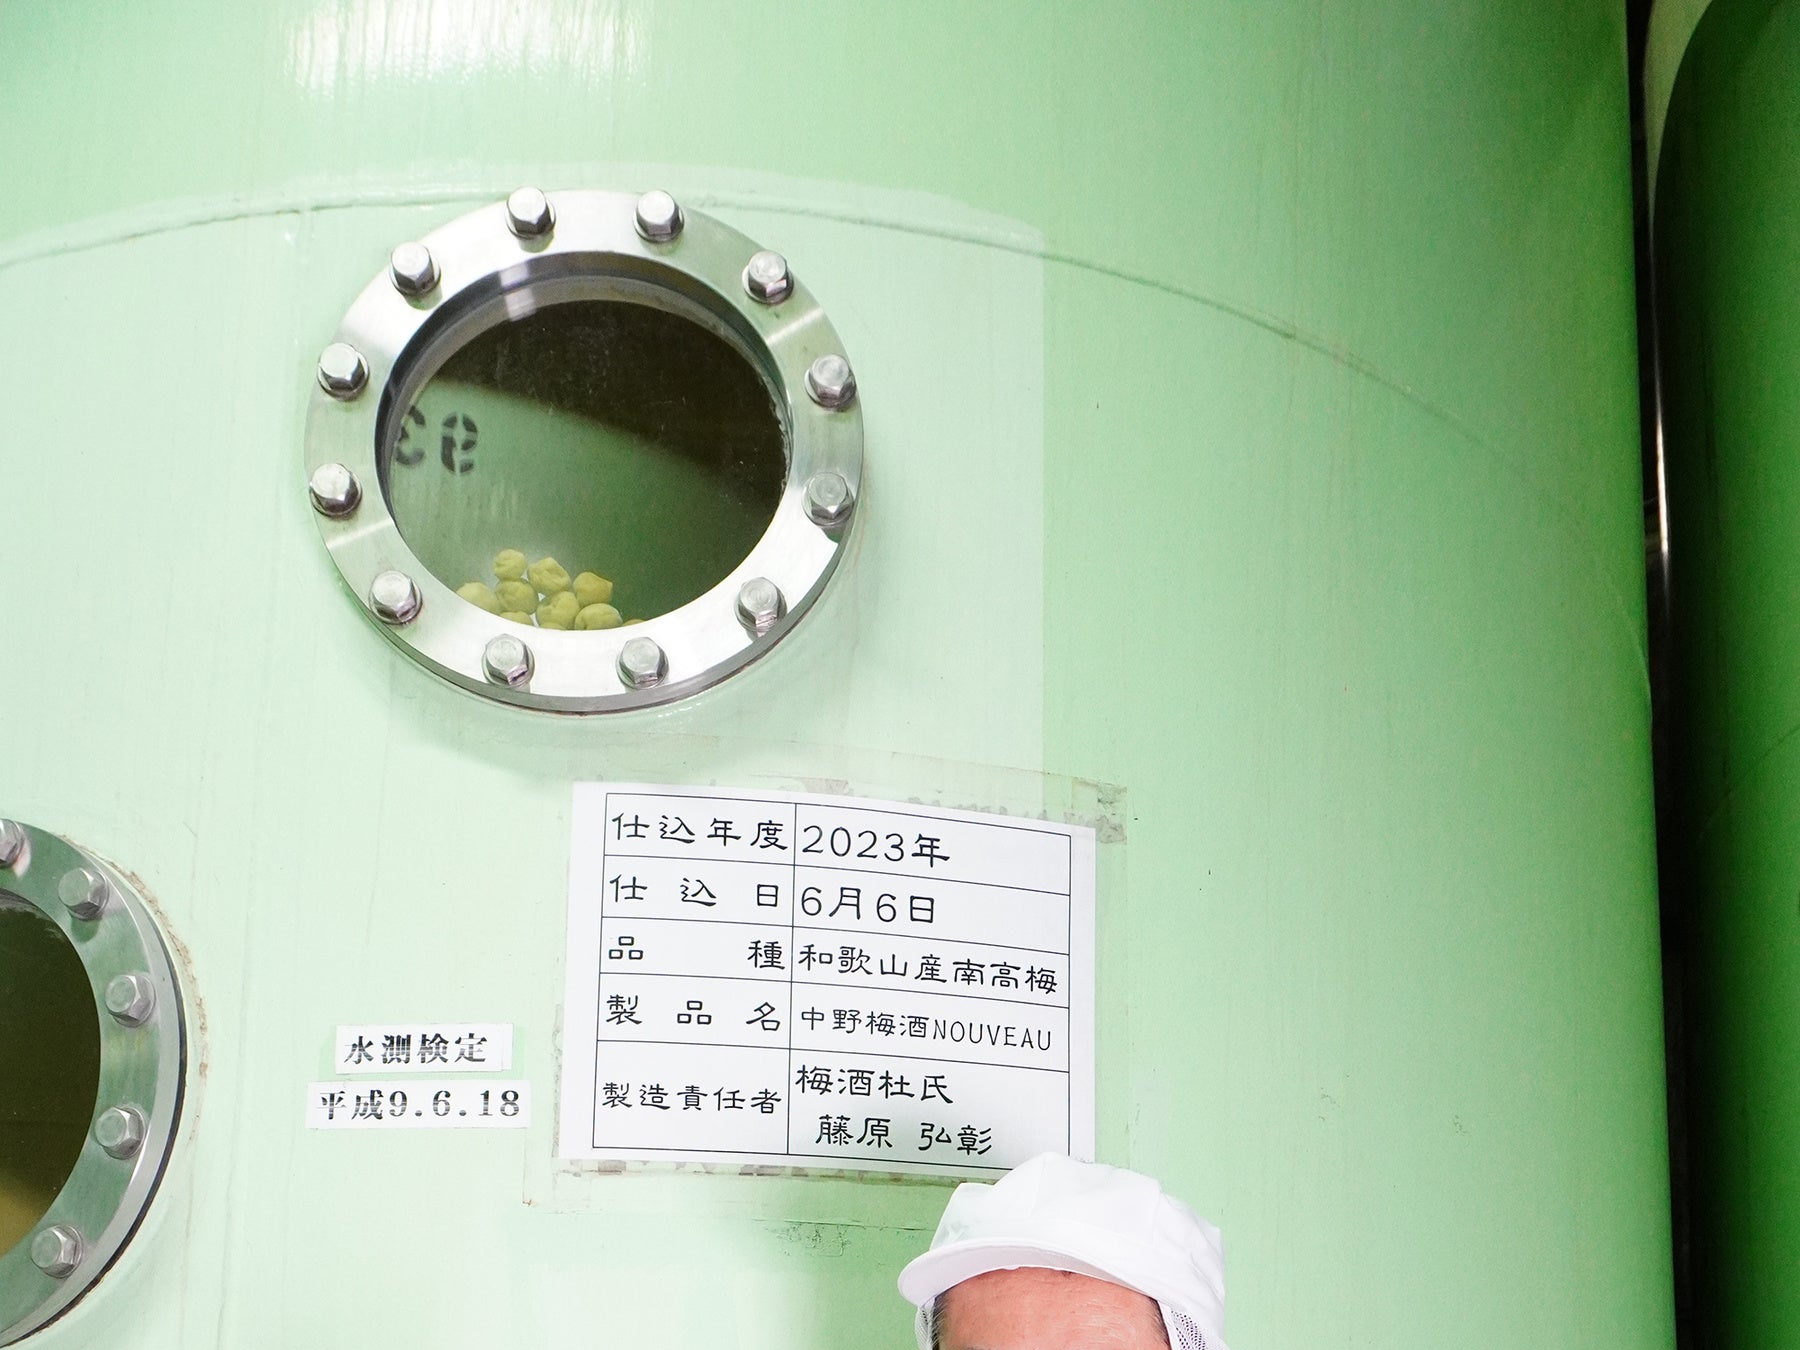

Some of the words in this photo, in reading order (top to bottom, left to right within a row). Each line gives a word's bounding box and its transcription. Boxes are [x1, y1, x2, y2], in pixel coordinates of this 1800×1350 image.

[611, 812, 788, 851] 仕込年度
[799, 826, 950, 867] 2023年
[801, 886, 935, 924] 6月6日
[798, 945, 1058, 995] 和歌山産南高梅
[344, 1032, 488, 1065] 水測検定
[601, 1081, 782, 1114] 製造責任者
[794, 1065, 954, 1104] 梅酒杜氏
[317, 1089, 519, 1120] 平成9.6.18
[815, 1113, 893, 1149] 藤原
